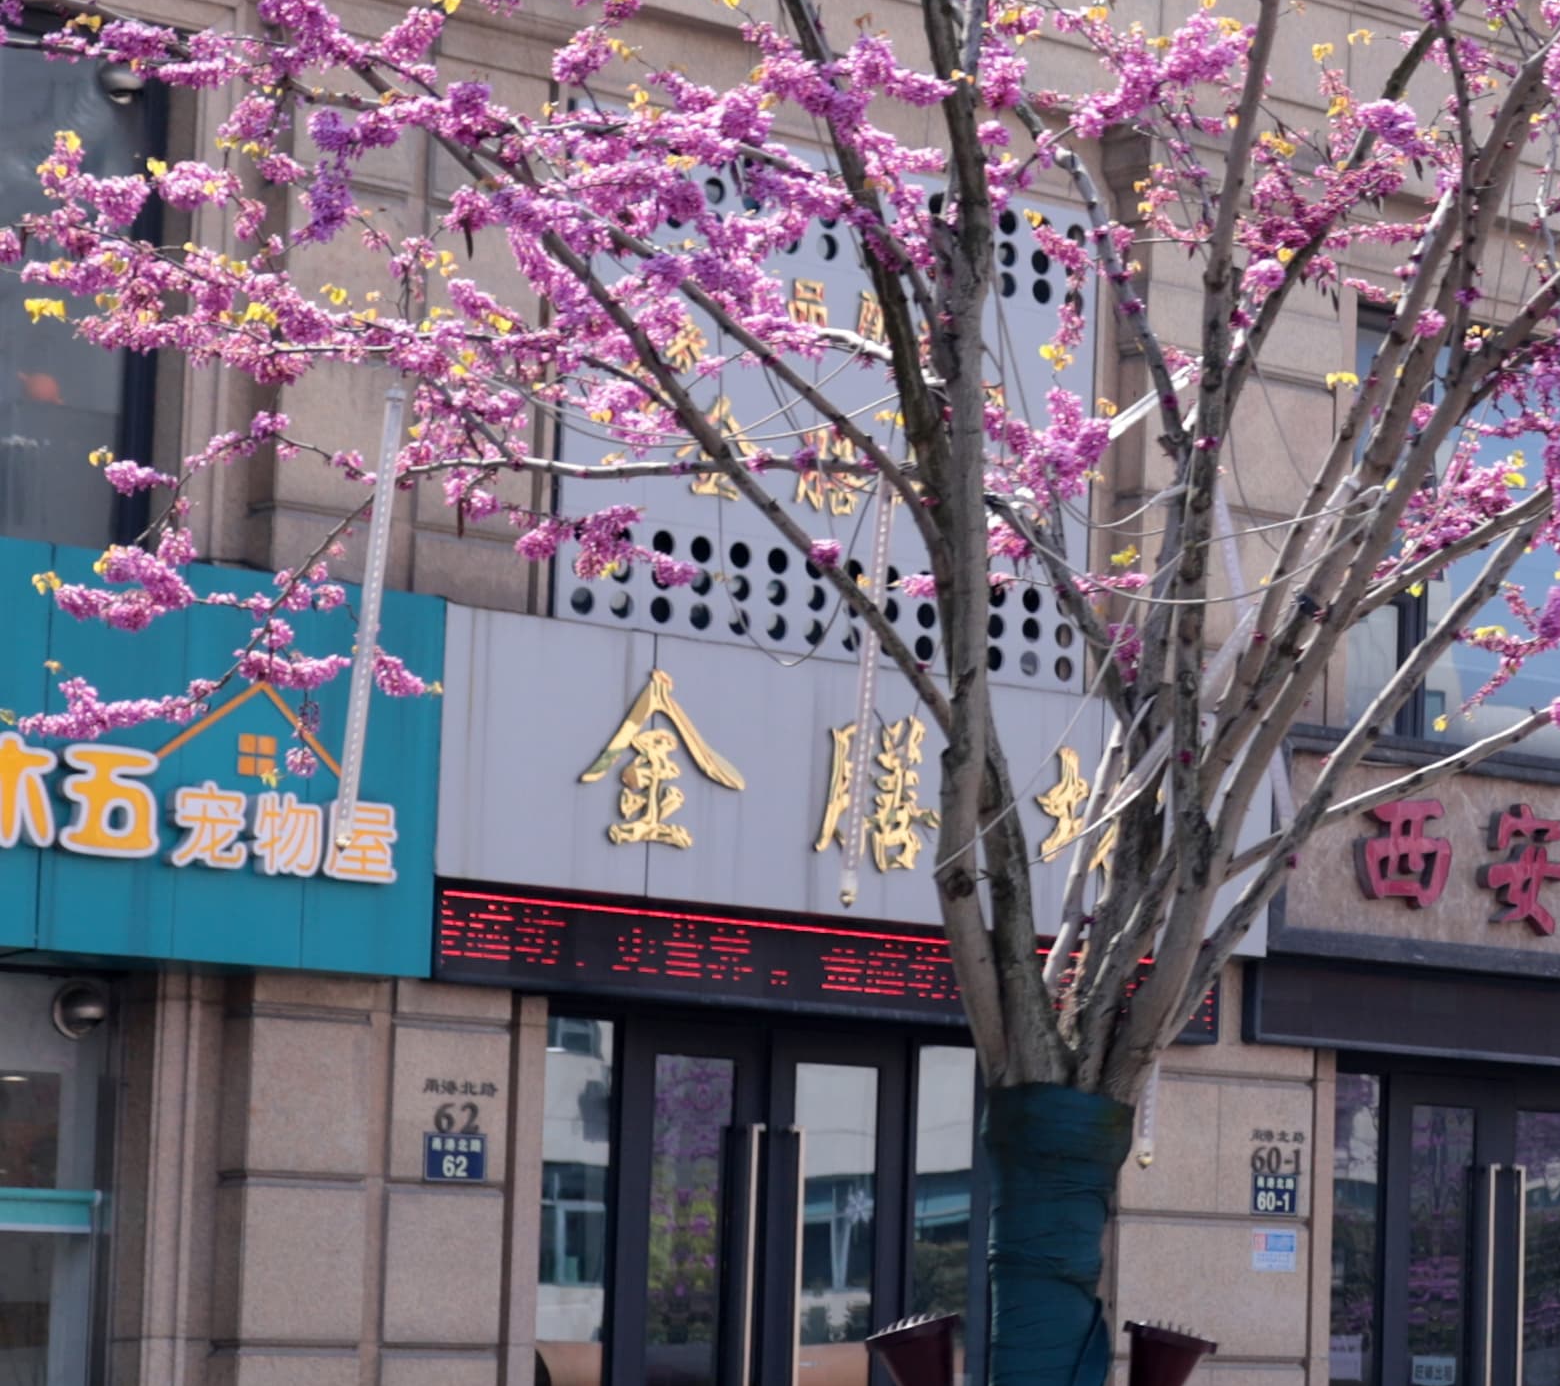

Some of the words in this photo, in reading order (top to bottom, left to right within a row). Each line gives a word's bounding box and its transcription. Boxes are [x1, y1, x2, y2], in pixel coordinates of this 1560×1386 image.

[172, 781, 398, 884] 宠物屋
[434, 1102, 480, 1133] 62
[442, 1154, 469, 1178] 62
[1250, 1145, 1302, 1175] 60-1
[1256, 1191, 1291, 1212] 60-1
